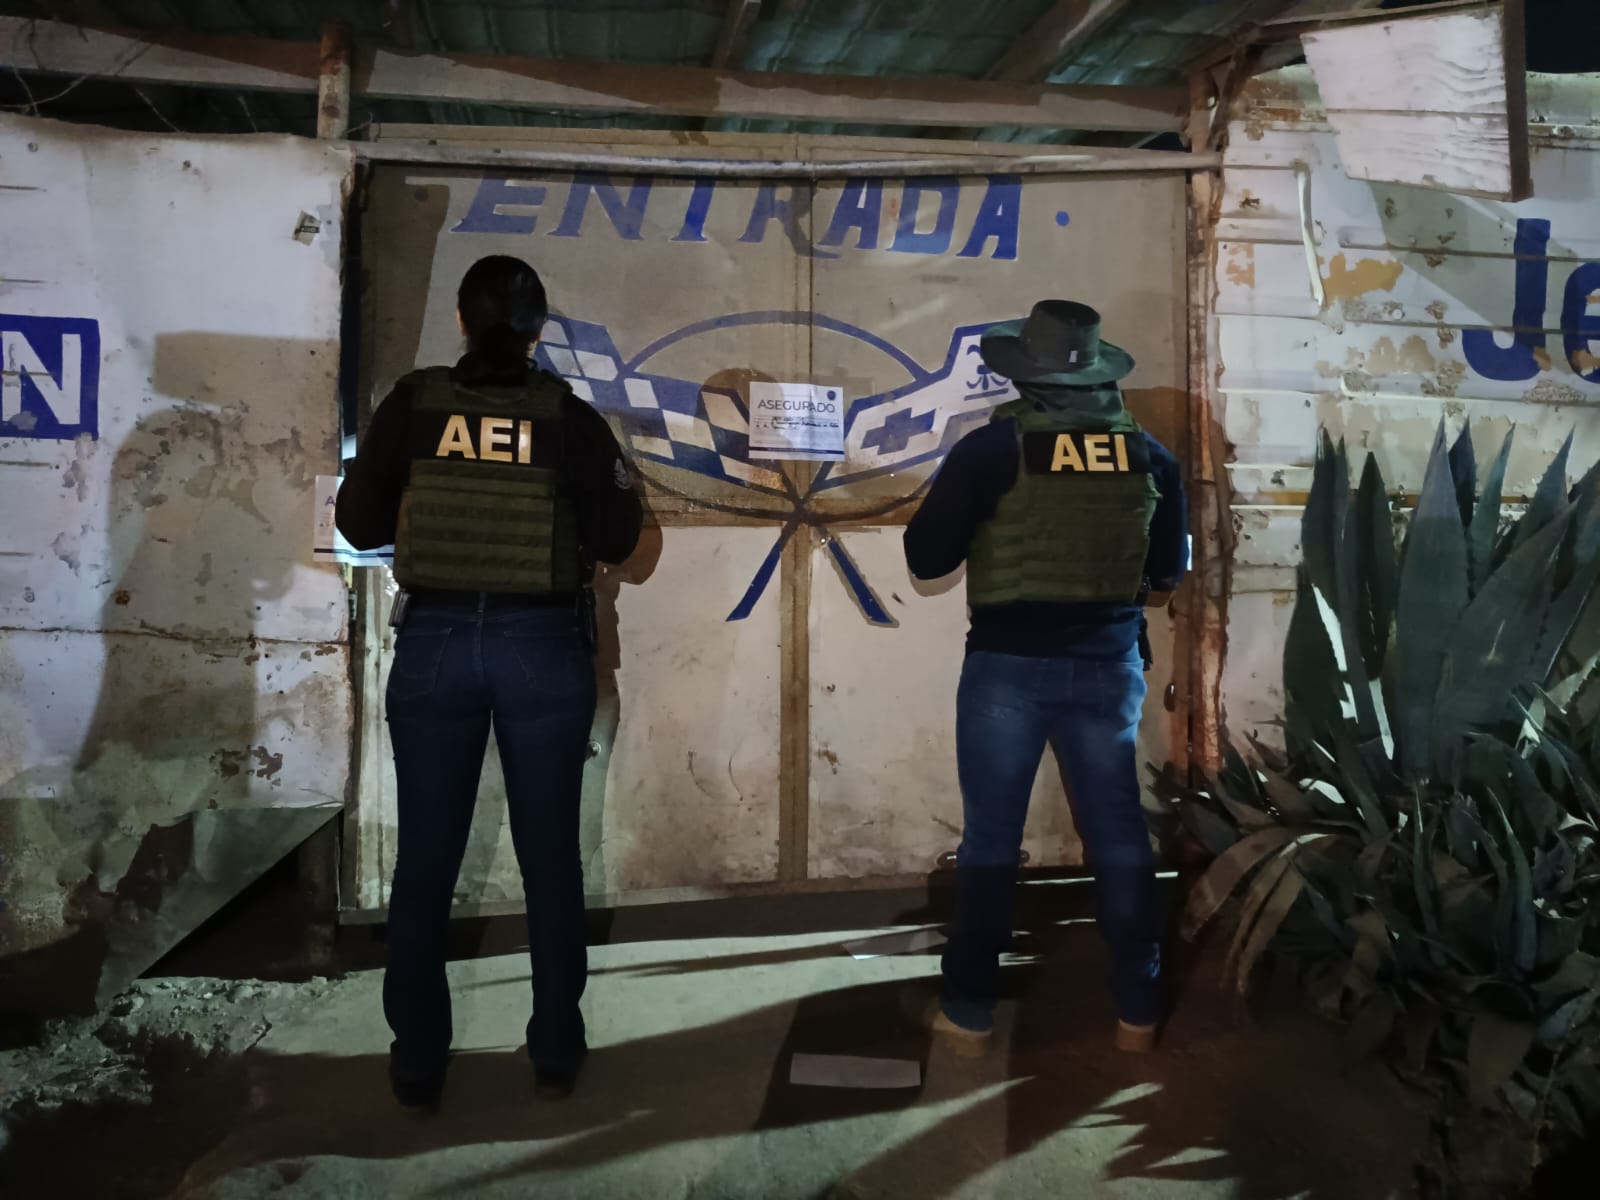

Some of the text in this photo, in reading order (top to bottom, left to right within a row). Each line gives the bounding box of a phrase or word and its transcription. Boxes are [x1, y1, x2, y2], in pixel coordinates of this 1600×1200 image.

[758, 399, 836, 414] ASEGURADO
[436, 414, 532, 464] AEI
[1050, 433, 1129, 472] AEI
